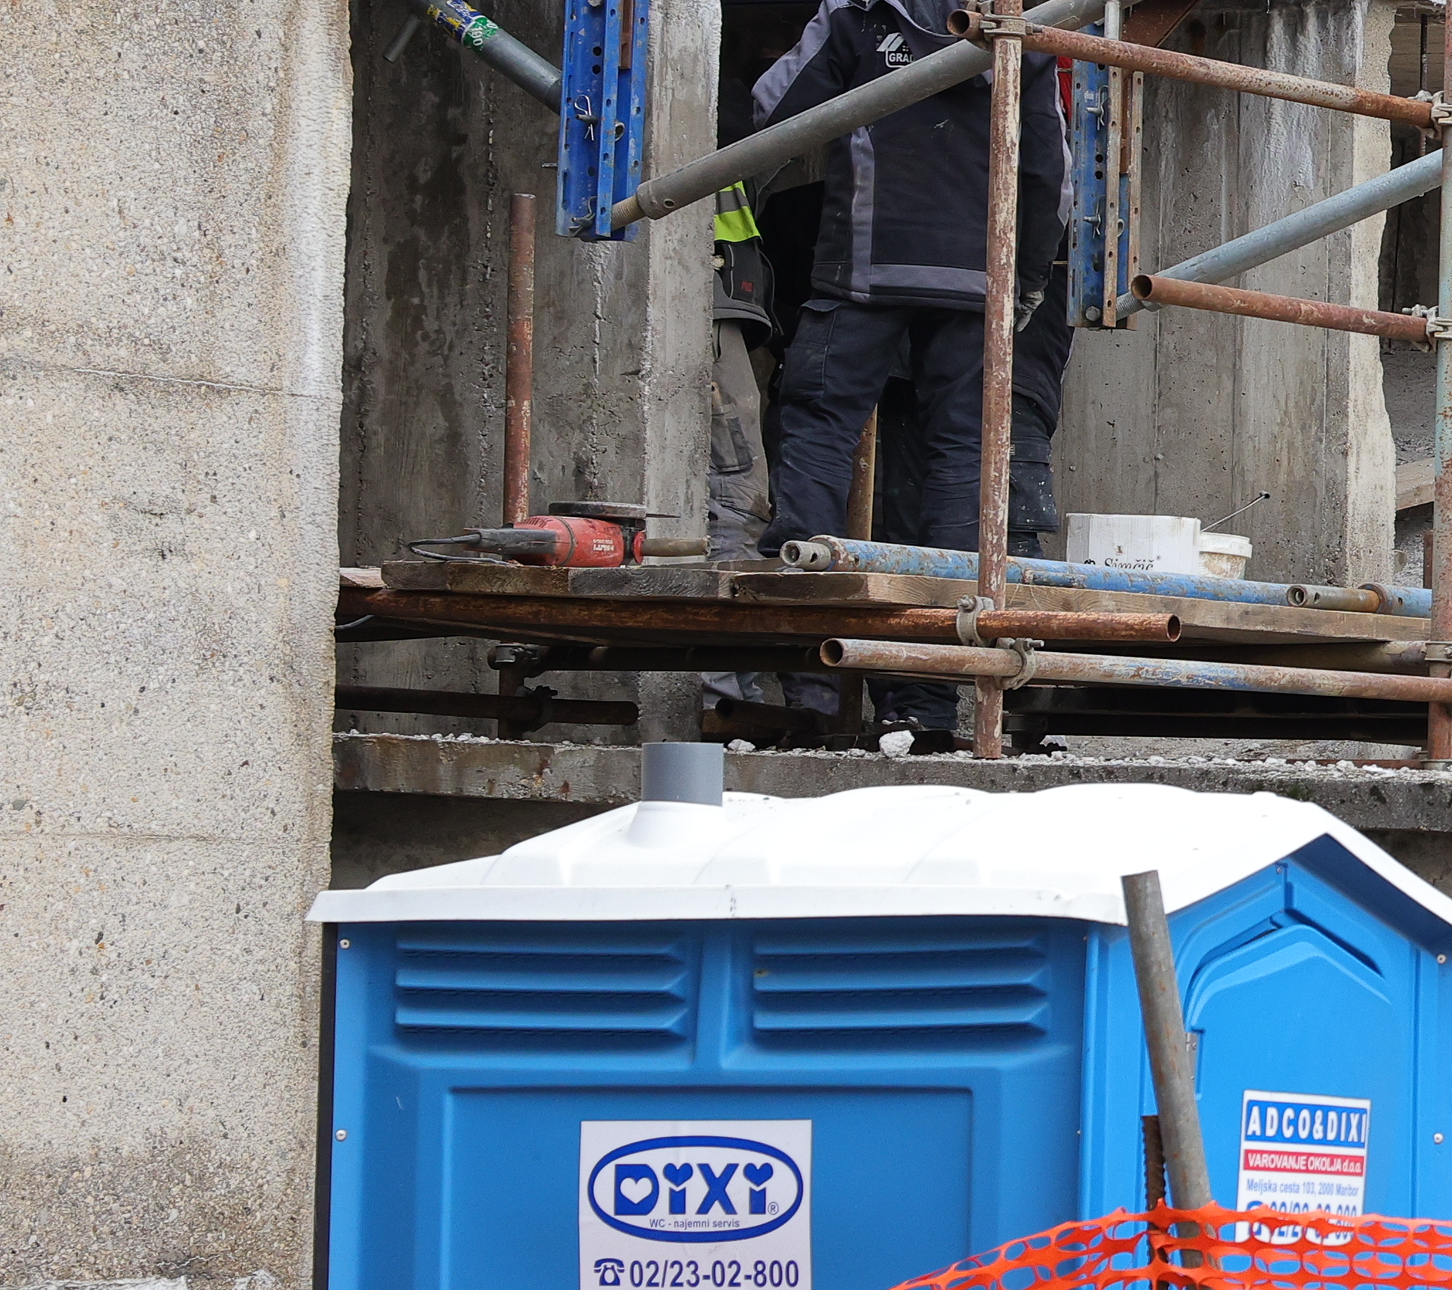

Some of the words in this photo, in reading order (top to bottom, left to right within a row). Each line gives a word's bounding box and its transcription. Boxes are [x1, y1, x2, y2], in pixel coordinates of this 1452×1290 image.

[1247, 1105, 1367, 1144] ADCO&DIXI
[1247, 1152, 1307, 1171] VAROVANJE
[1308, 1156, 1342, 1172] OKOLJA
[1246, 1178, 1277, 1195] Meljska
[1280, 1180, 1300, 1193] cesta
[1318, 1182, 1334, 1196] 2000
[1335, 1183, 1359, 1197] Maribor
[649, 1219, 665, 1228] WC
[674, 1218, 710, 1230] najemni
[712, 1219, 740, 1228] servis
[629, 1259, 799, 1288] 02/23-02-800
